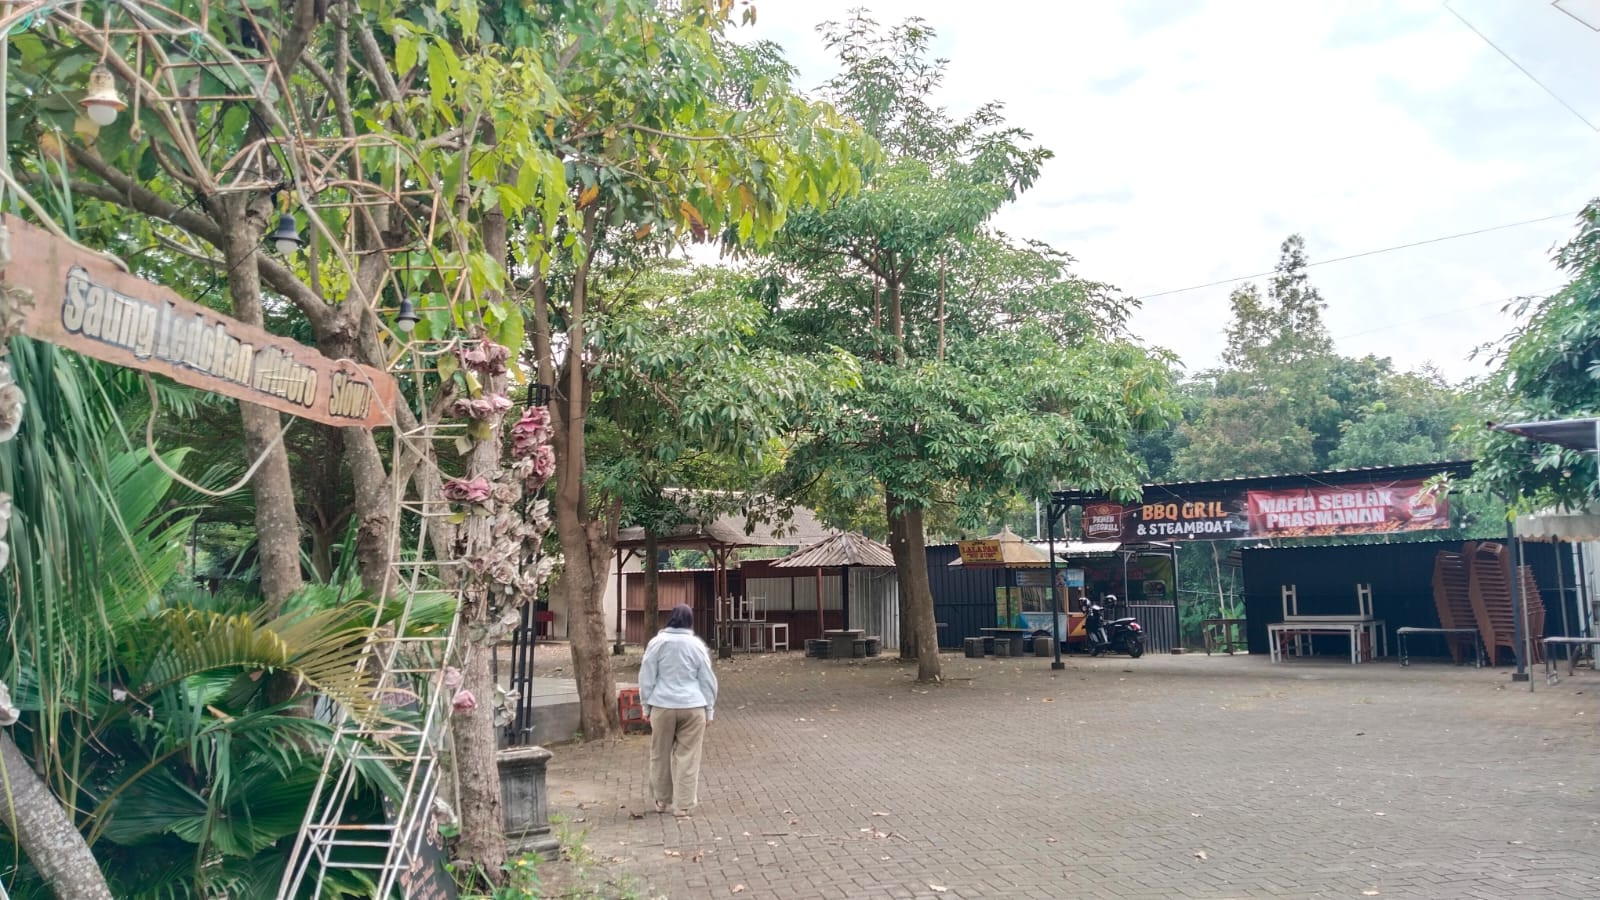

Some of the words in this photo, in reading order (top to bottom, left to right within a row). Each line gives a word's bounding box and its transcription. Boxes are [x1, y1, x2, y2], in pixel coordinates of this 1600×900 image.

[62, 265, 158, 360] Saung
[157, 300, 253, 388] Ledokan
[1142, 503, 1178, 521] BBQ
[1181, 501, 1229, 519] GRIL
[1259, 494, 1316, 513] MAFIA
[1318, 490, 1393, 510] SEBLAK
[1136, 523, 1147, 536] &
[1149, 520, 1233, 535] STEAMBOAT
[1265, 507, 1386, 528] PRASMANAN
